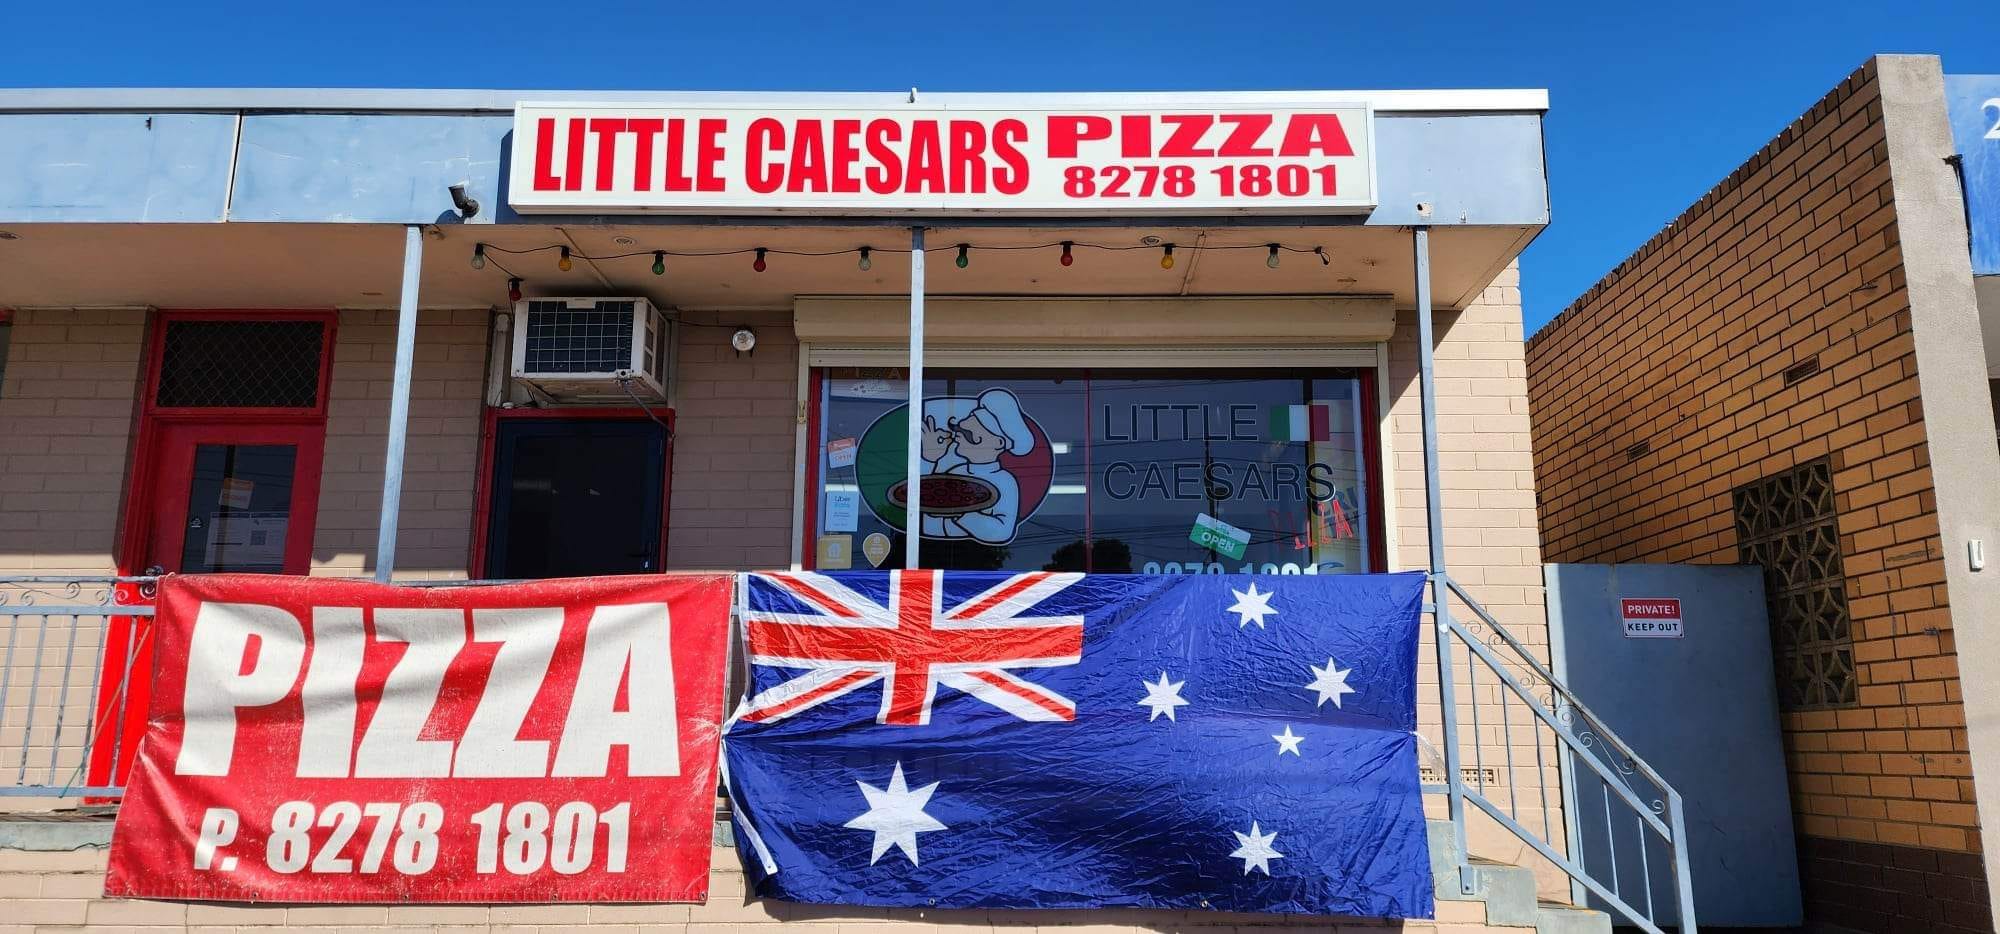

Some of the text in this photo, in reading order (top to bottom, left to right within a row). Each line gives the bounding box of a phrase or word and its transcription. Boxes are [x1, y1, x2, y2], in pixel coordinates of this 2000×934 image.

[1047, 114, 1353, 158] PIZZA
[534, 117, 1029, 195] LITTLE CAESARS
[1063, 165, 1337, 198] 8278 1801
[1103, 404, 1259, 441] LITTLE
[1103, 461, 1336, 501] CAESARS
[1201, 531, 1236, 552] OPEN
[1627, 605, 1675, 615] PRIVATE!
[1627, 623, 1678, 631] KEEP OUT
[175, 601, 681, 779] PIZZA
[194, 801, 631, 876] P. 8278 1801
